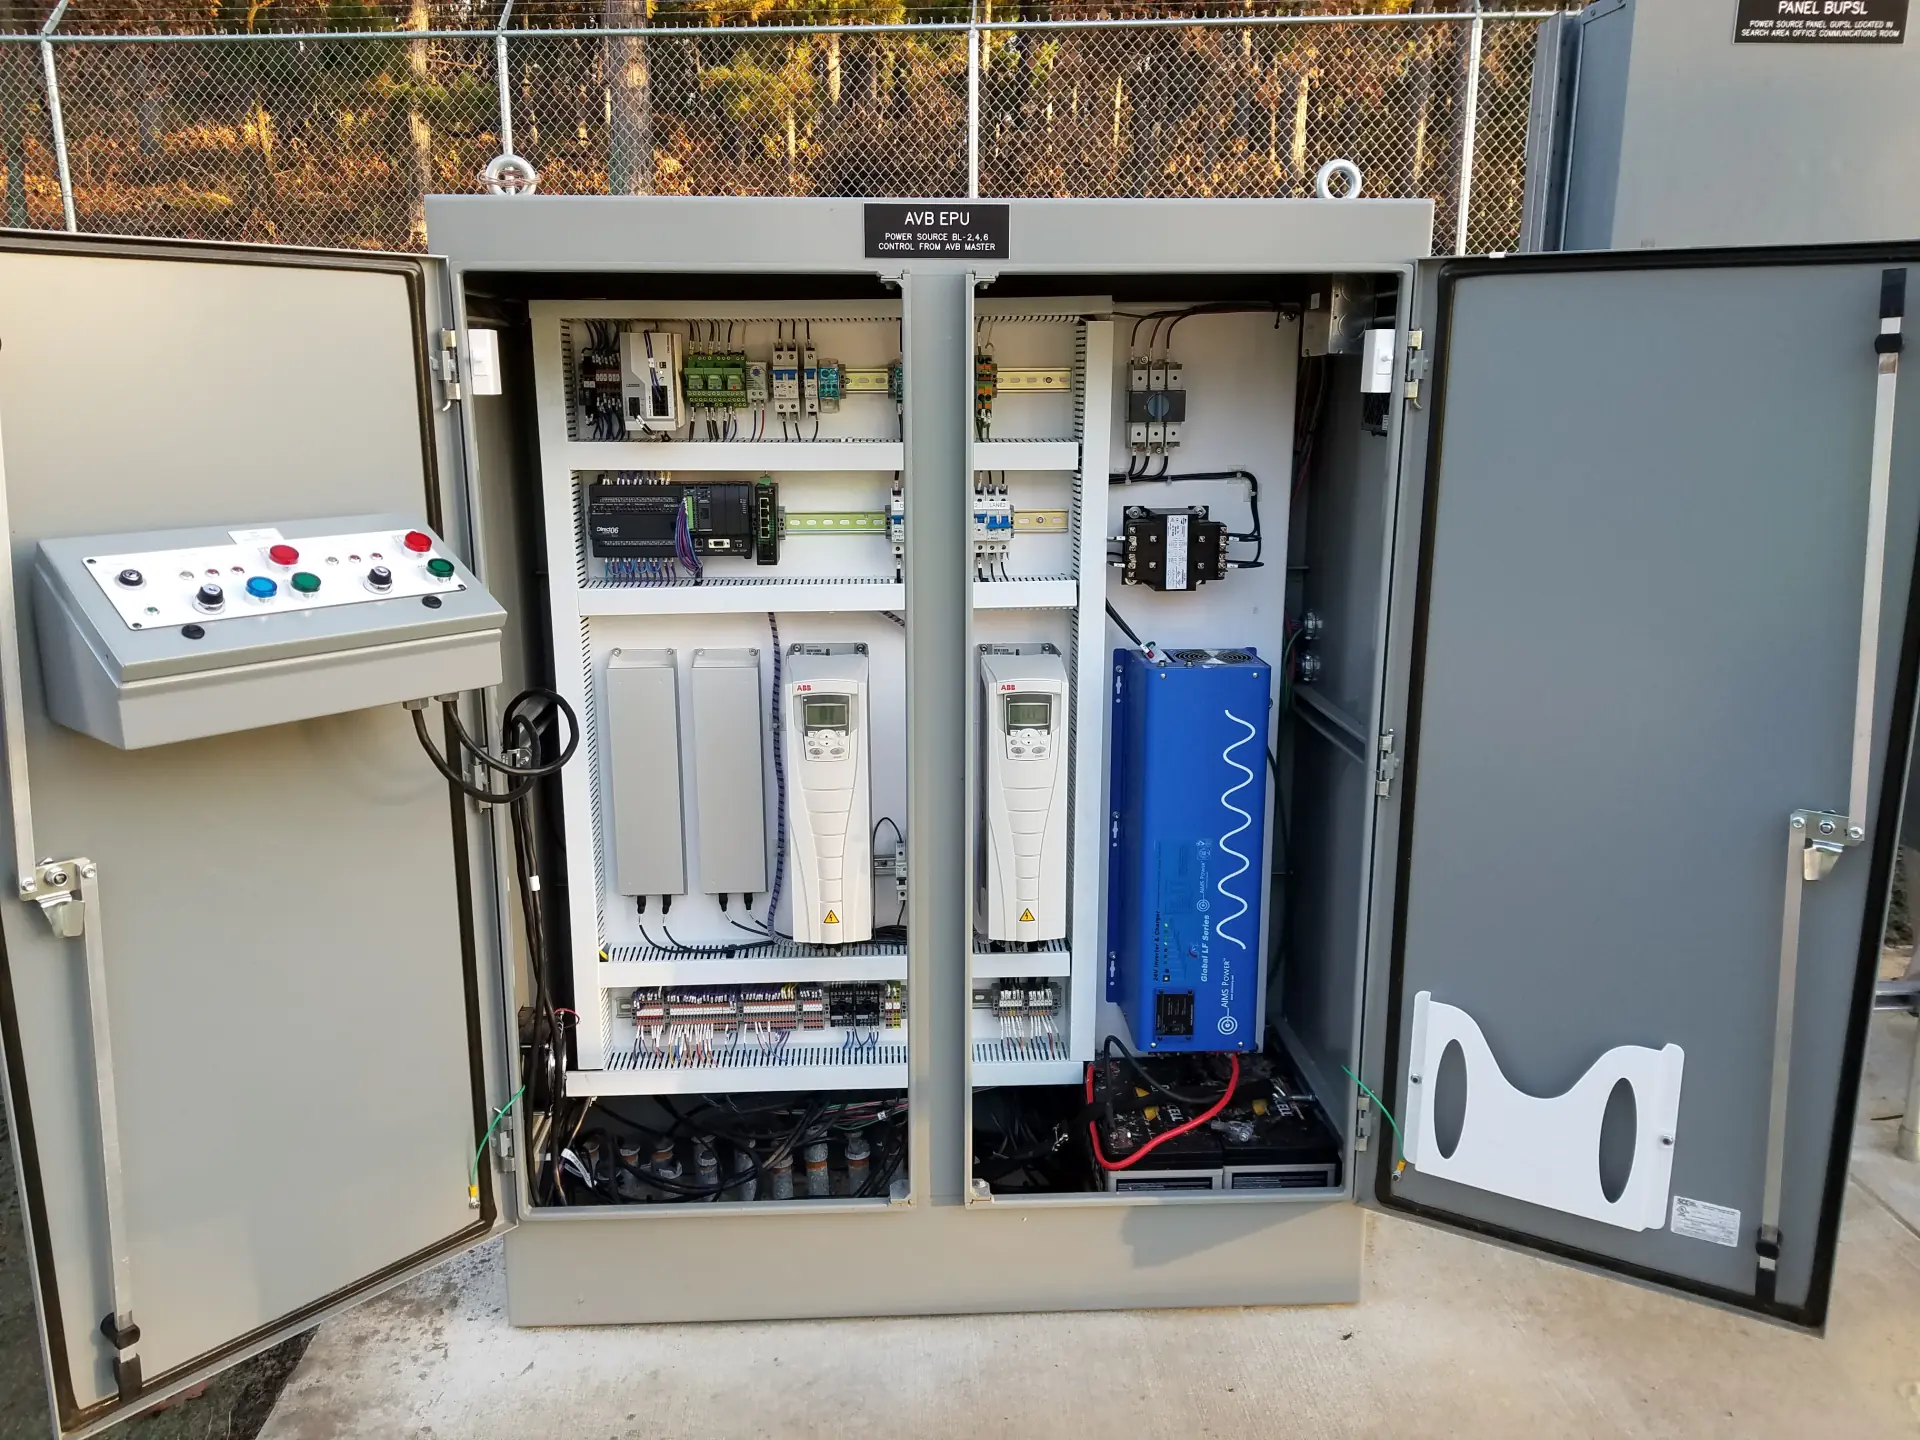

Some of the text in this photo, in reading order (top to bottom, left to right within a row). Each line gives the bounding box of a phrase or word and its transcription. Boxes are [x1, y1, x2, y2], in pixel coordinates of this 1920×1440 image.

[1778, 1, 1868, 14] PANEL BUPSL
[1750, 20, 1774, 28] POWER
[1776, 20, 1803, 28] SOURCE
[1806, 20, 1827, 28] PANEL
[1854, 20, 1884, 29] LOCATED
[1886, 20, 1893, 28] IN
[1741, 29, 1769, 37] SEARCH
[1771, 29, 1789, 37] AREA
[1879, 30, 1899, 38] ROOM
[904, 211, 970, 226] AVB EPU
[885, 232, 912, 241] POWER
[917, 233, 948, 241] SOURCE
[878, 242, 996, 250] CONTROL FROM AVB MASTER
[1200, 914, 1210, 982] Global LF Series
[1221, 988, 1229, 1008] AIMS
